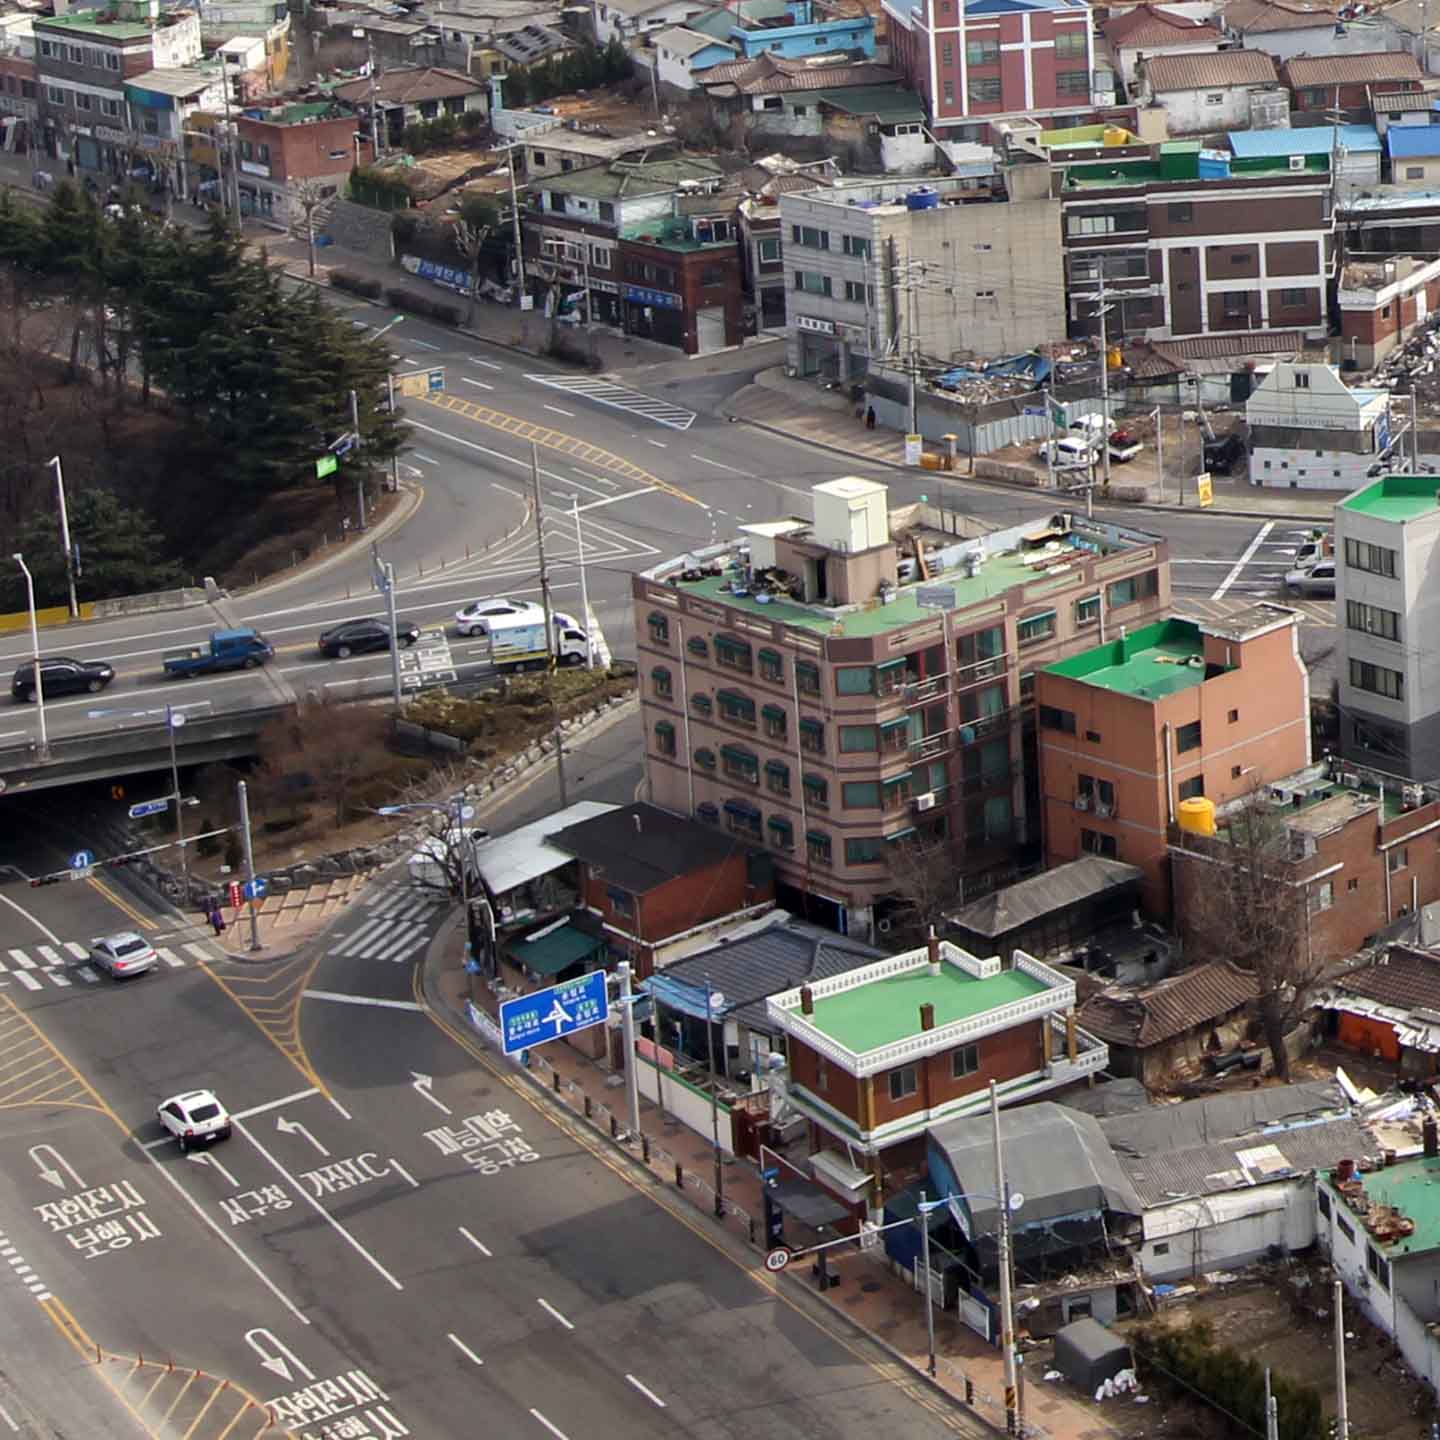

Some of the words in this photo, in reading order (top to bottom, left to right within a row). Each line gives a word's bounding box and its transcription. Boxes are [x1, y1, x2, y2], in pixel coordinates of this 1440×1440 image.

[423, 1108, 523, 1155] 재능대학
[299, 1152, 391, 1197] 가좌IC
[461, 1136, 541, 1175] 동구청
[218, 1184, 294, 1226] 서구청
[65, 1211, 163, 1259] 보행시
[770, 1253, 785, 1266] 60
[302, 1406, 411, 1440] 행시
